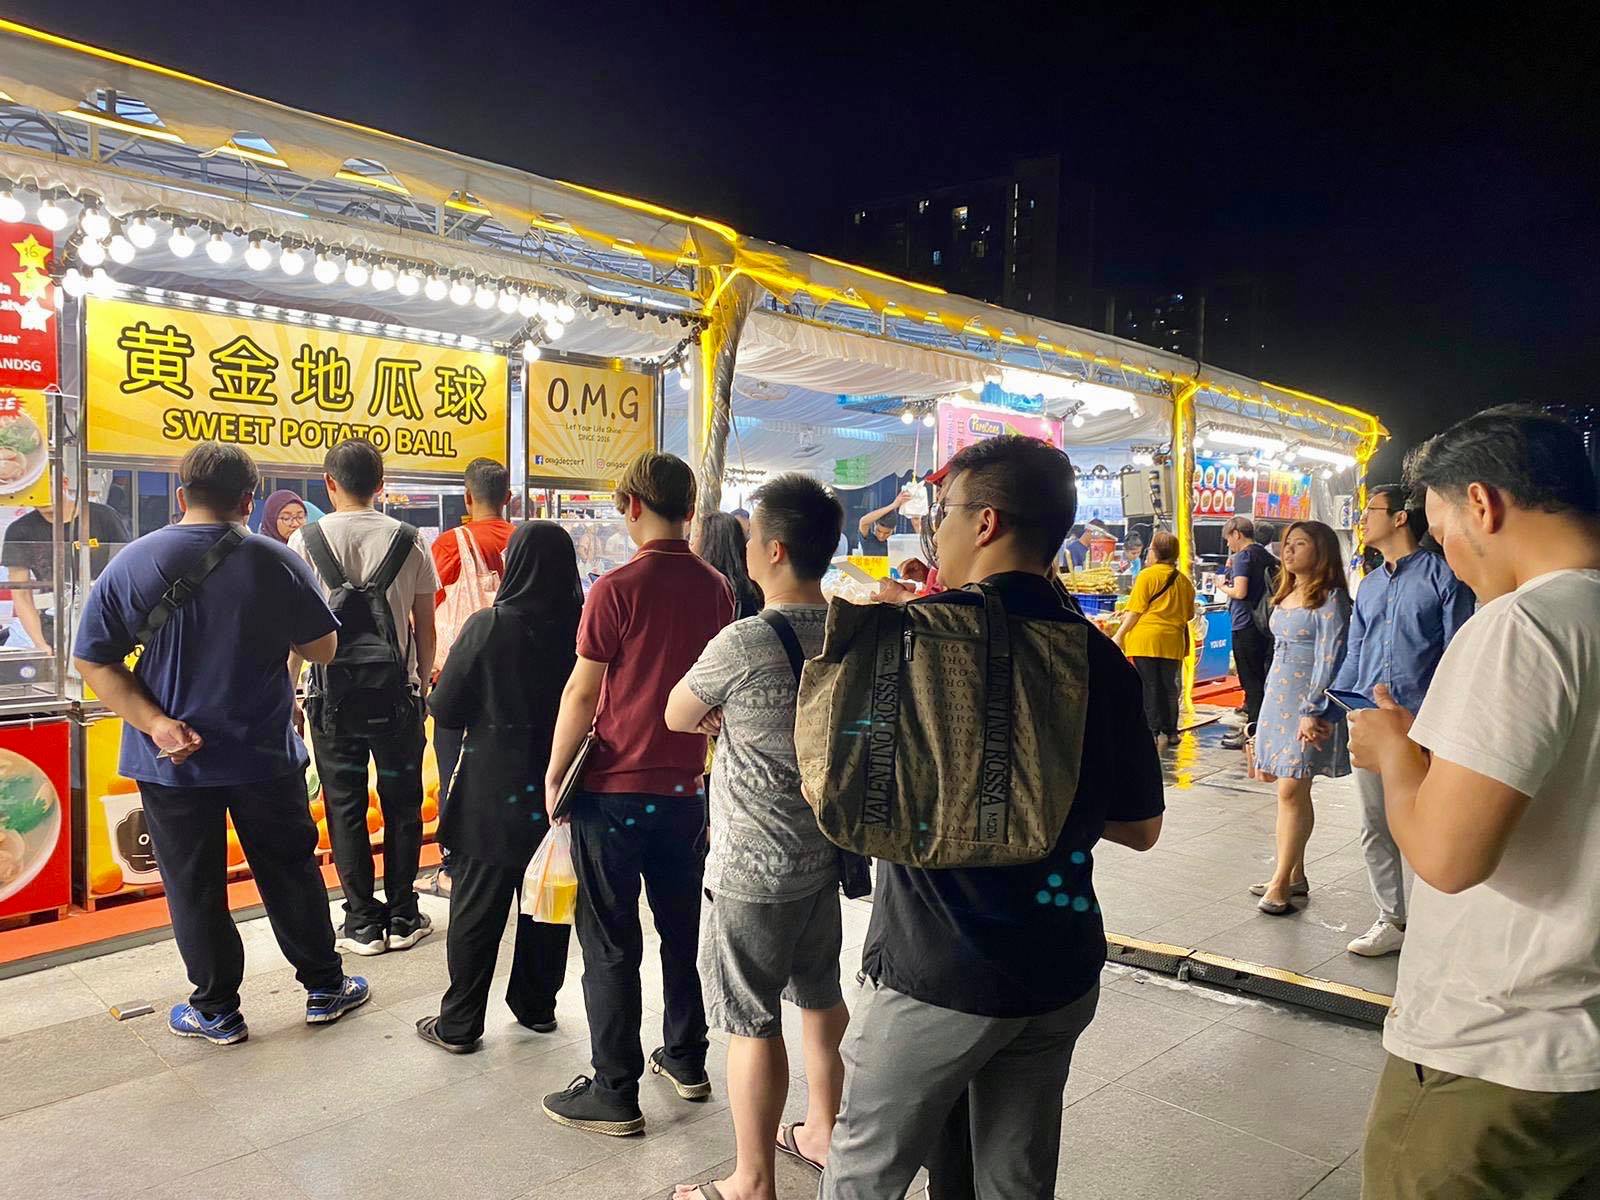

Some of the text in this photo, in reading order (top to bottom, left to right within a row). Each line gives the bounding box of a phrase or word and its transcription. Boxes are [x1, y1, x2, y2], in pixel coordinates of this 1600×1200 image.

[547, 377, 639, 422] O.M.G
[162, 408, 276, 445] SWEET
[395, 428, 457, 458] BALL
[565, 422, 576, 430] Let
[577, 424, 592, 432] Your
[578, 433, 595, 441] SINCE
[873, 671, 899, 725] ROSSA
[864, 730, 894, 824] VALENTINO
[983, 749, 1009, 807] ROSSA
